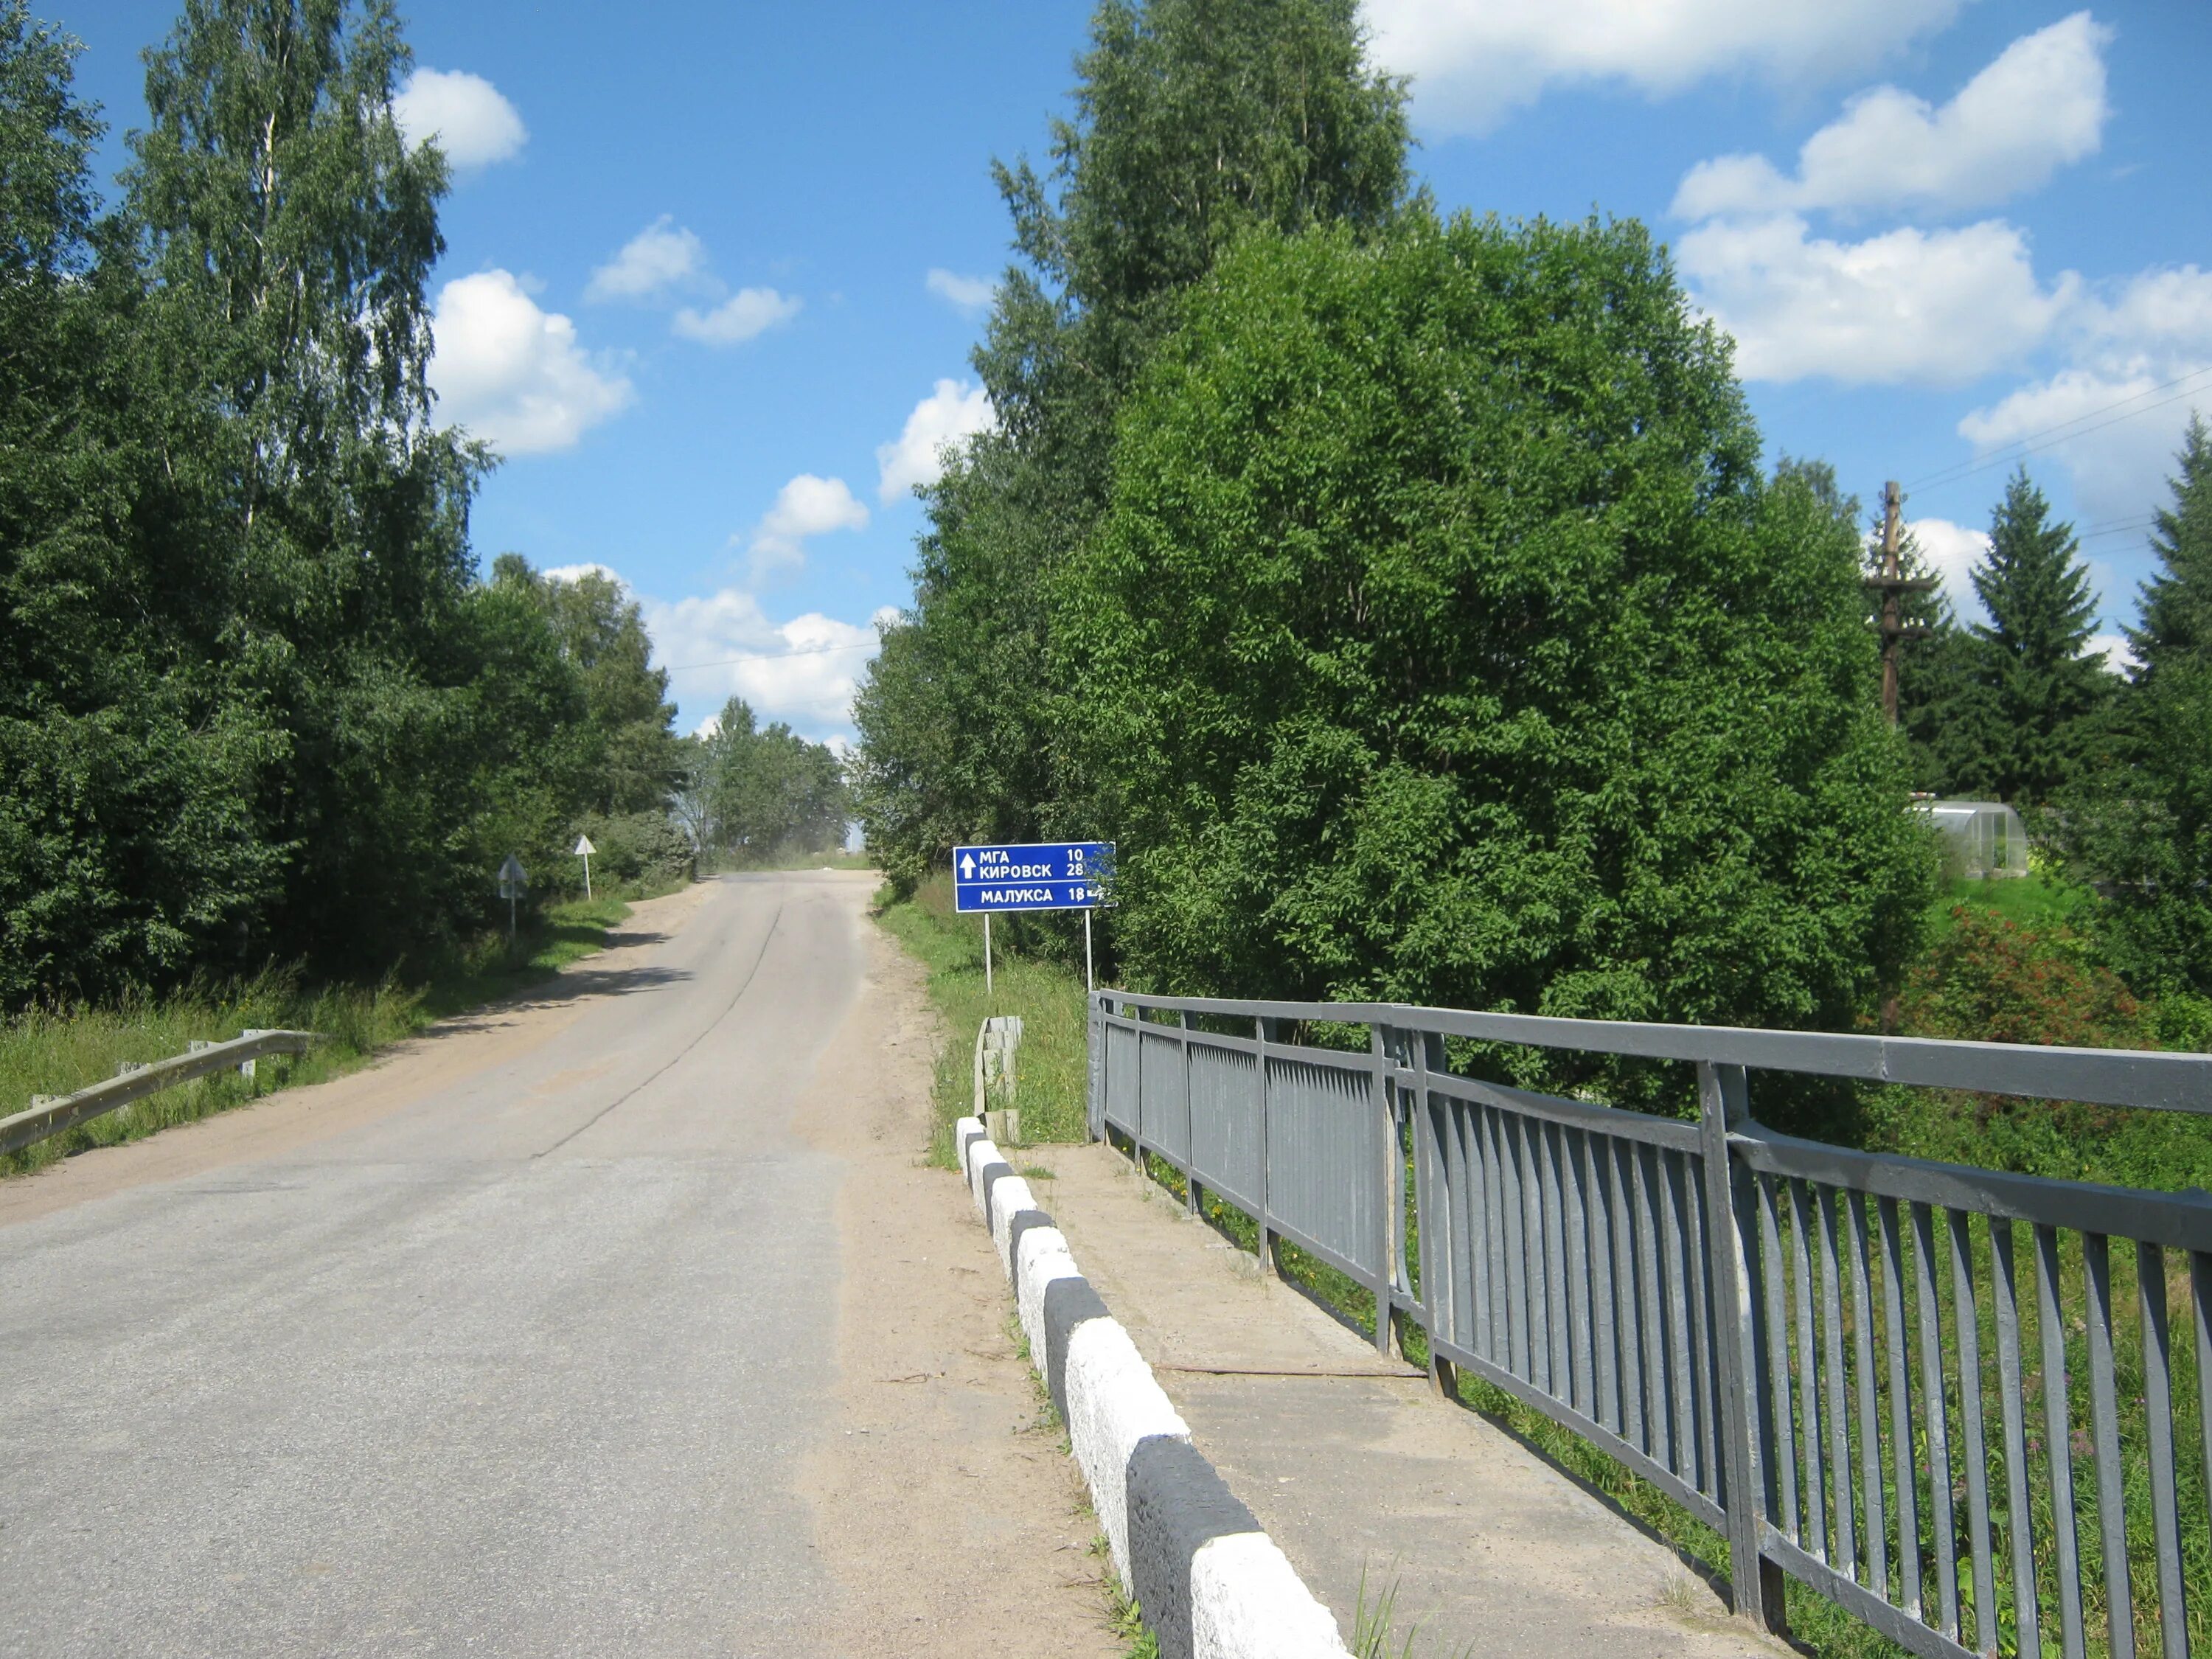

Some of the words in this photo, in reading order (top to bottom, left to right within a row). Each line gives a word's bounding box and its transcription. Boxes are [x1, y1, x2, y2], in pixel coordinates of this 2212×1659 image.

[979, 850, 1010, 864] МГА
[1067, 848, 1084, 862] 10
[979, 864, 1052, 880] КИРОВСК
[1066, 863, 1084, 876] 28
[981, 888, 1053, 903] МАЛУКСА
[1068, 887, 1085, 901] 18
